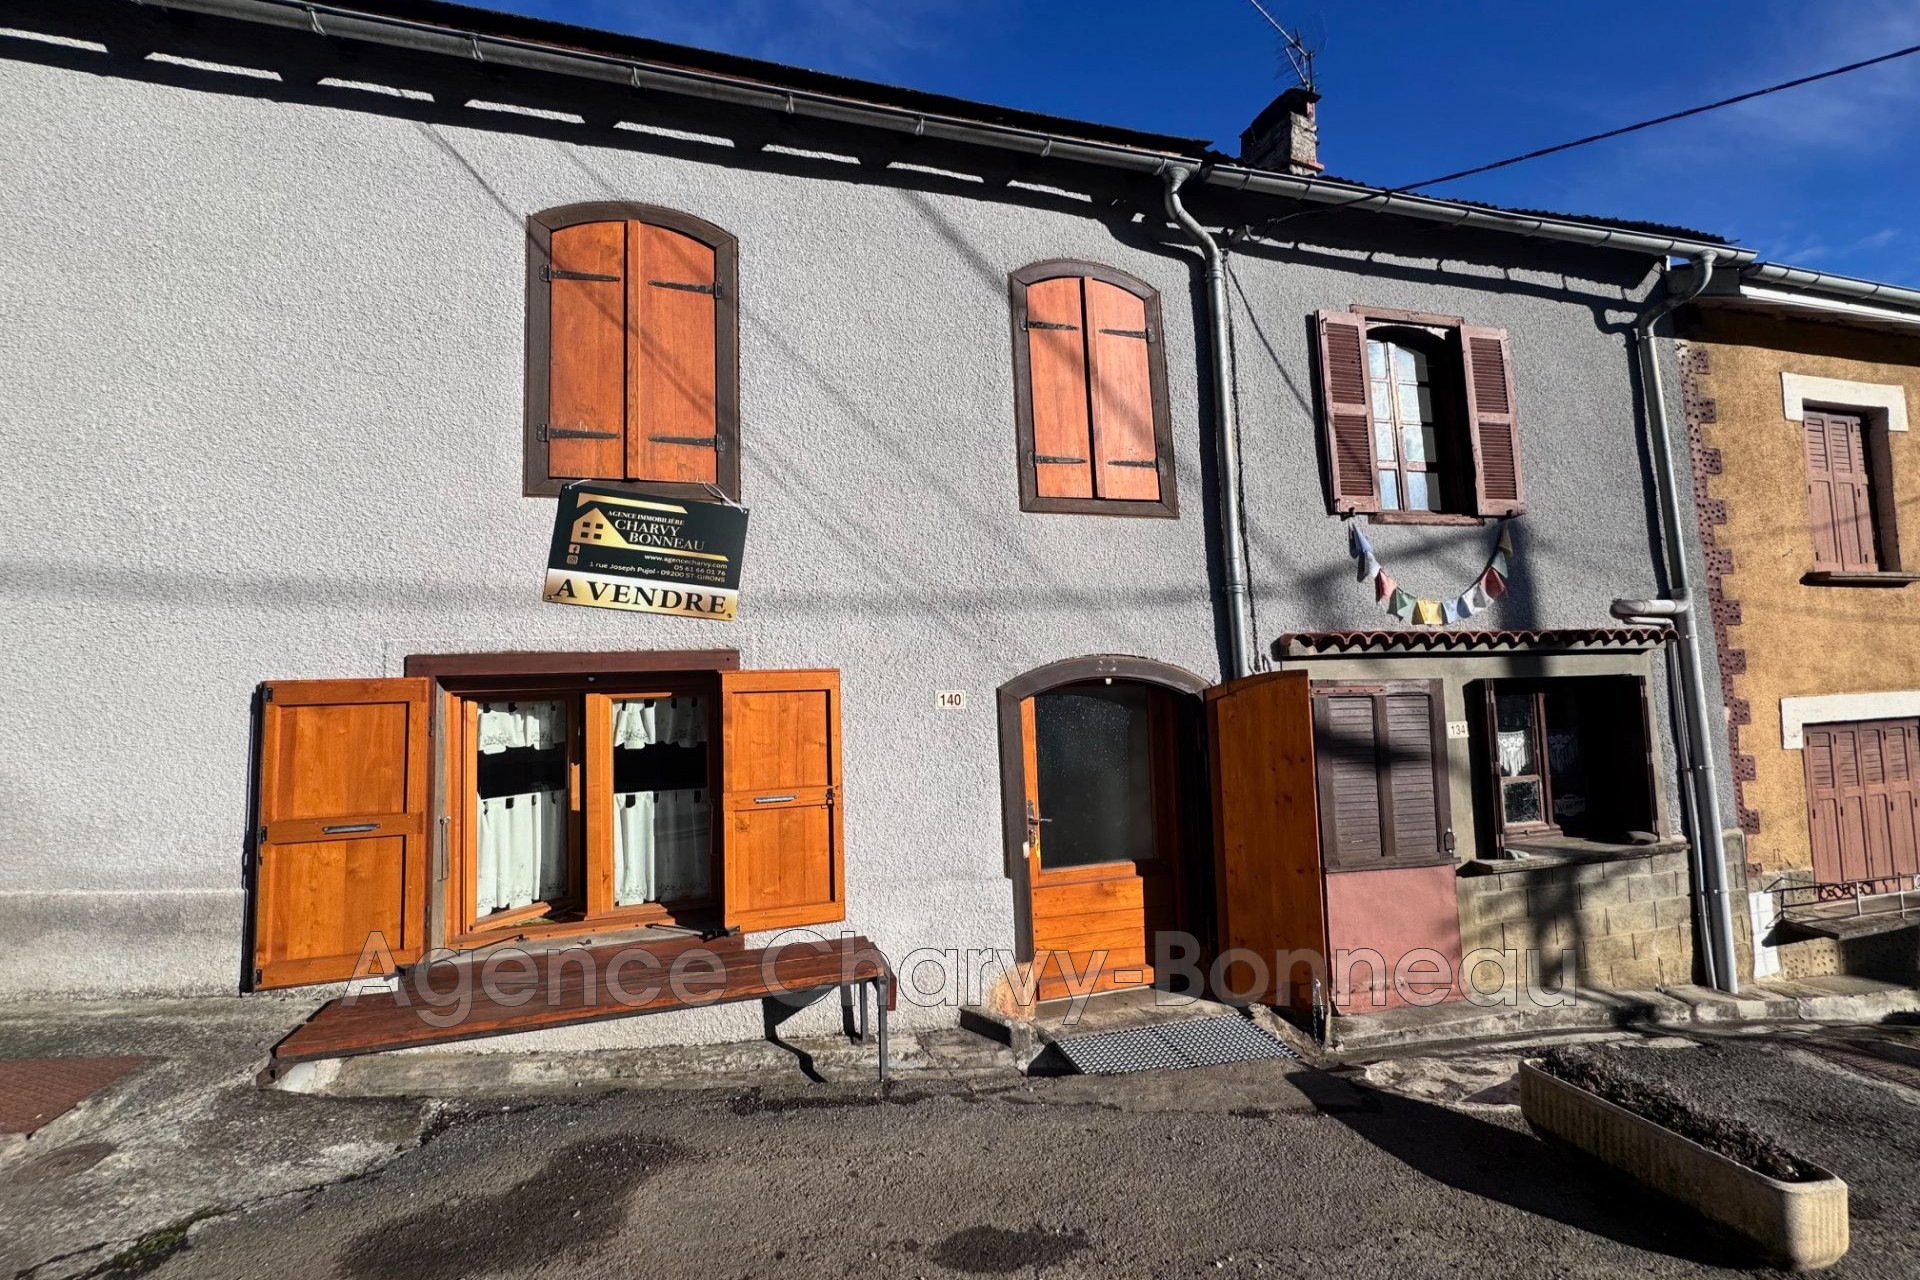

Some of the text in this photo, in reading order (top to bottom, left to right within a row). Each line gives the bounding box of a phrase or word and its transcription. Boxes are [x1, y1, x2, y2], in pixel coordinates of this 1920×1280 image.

[607, 510, 637, 519] AGENCE
[614, 519, 680, 537] CHARVY
[629, 531, 705, 551] BONNEAU
[644, 554, 728, 570] www.agencecharvy.com
[609, 563, 636, 573] Joseph
[637, 566, 656, 575] Pujol
[660, 569, 685, 578] 09200
[554, 578, 727, 615] A VENDRE
[940, 693, 962, 706] 140
[1450, 724, 1466, 736] 134
